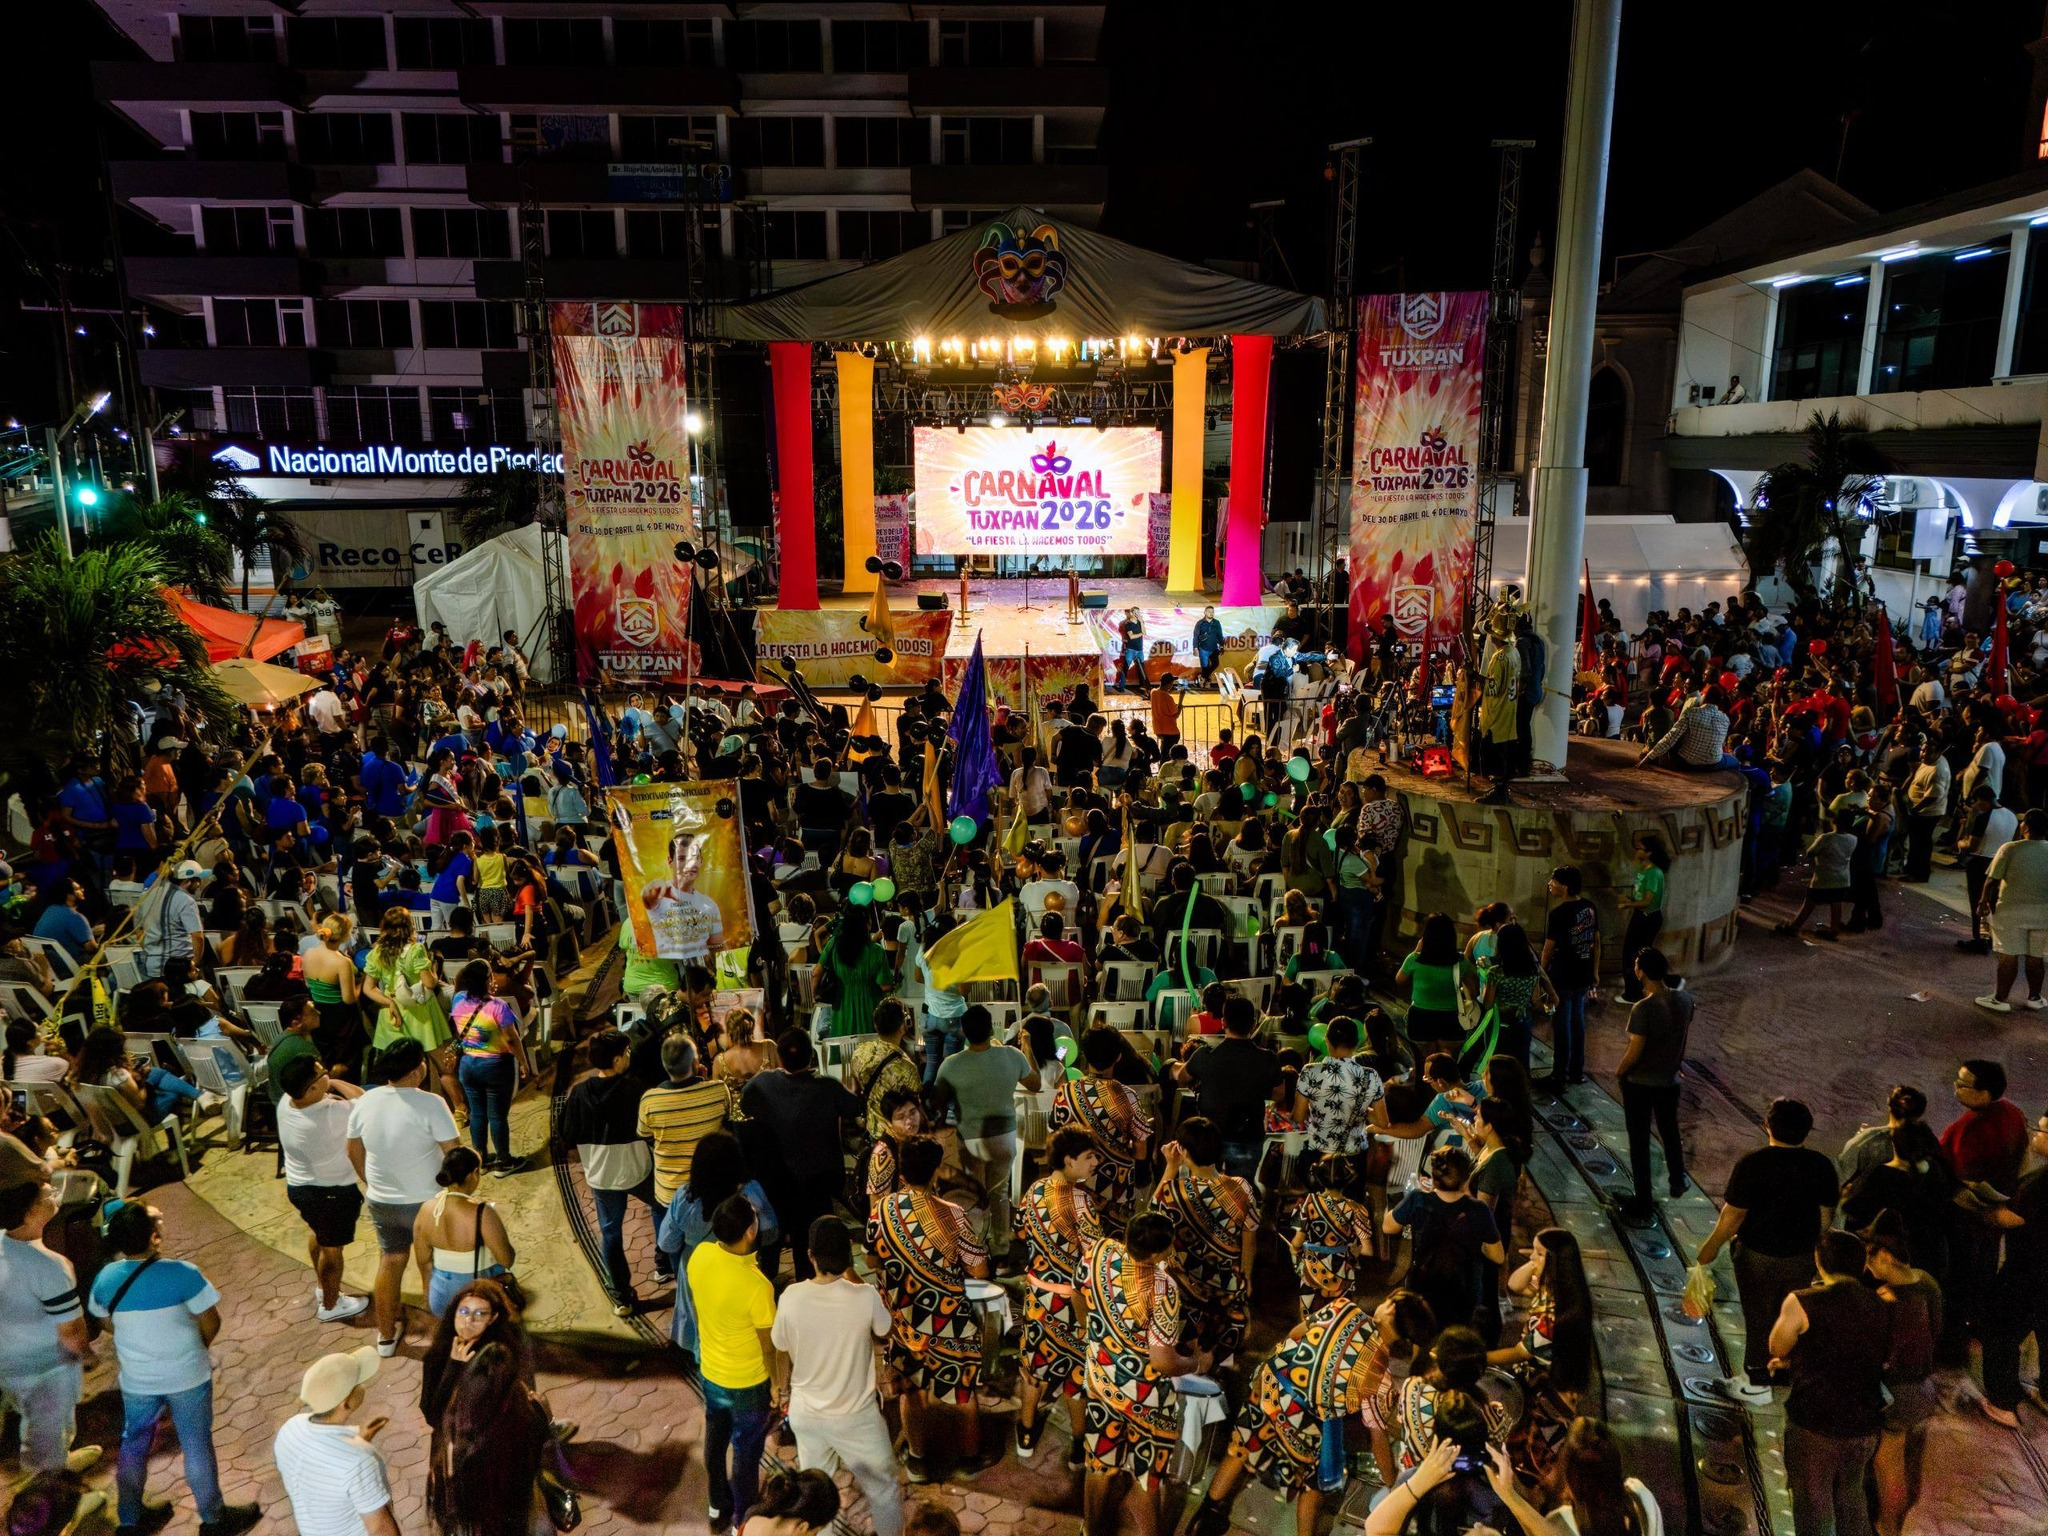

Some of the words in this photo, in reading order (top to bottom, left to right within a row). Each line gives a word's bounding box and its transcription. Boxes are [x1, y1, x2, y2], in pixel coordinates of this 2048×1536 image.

[1379, 348, 1464, 367] TUXPAN
[269, 446, 374, 473] Nacional
[377, 446, 456, 473] Monte
[458, 446, 488, 473] de
[1370, 445, 1469, 474] CARNAVAL
[580, 459, 680, 486] CARNAVAL
[1371, 475, 1420, 491] TUXPAN
[1421, 467, 1469, 489] 2026
[584, 487, 632, 503] TUXPAN
[632, 482, 680, 503] 2026
[963, 469, 1111, 507] CARNAVAL
[596, 506, 618, 514] FIESTA
[619, 507, 627, 515] LA
[628, 507, 657, 515] HACEMOS
[966, 510, 1039, 530] TUXPAN
[1040, 500, 1112, 530] 2026
[1362, 514, 1376, 523] DEL
[1378, 516, 1386, 524] 30
[1388, 515, 1397, 523] DE
[1399, 512, 1419, 522] ABRIL
[1432, 509, 1437, 517] 4
[1439, 508, 1448, 516] DE
[1450, 508, 1468, 517] MAYO
[580, 524, 593, 535] DEL
[594, 527, 602, 536] 30
[604, 527, 613, 536] DE
[615, 525, 634, 535] ABRIL
[636, 523, 645, 533] AL
[646, 522, 652, 531] 4
[654, 522, 663, 531] DE
[665, 522, 685, 533] MAYO
[985, 536, 1016, 545] FIESTA
[1032, 535, 1074, 545] HACEMOS
[318, 543, 400, 566] Reco
[770, 644, 810, 658] FIESTA
[814, 643, 828, 656] LA
[831, 639, 877, 655] HACEMO
[896, 639, 931, 655] ODOS!
[1175, 640, 1189, 652] LA
[599, 655, 682, 670] TUXPAN
